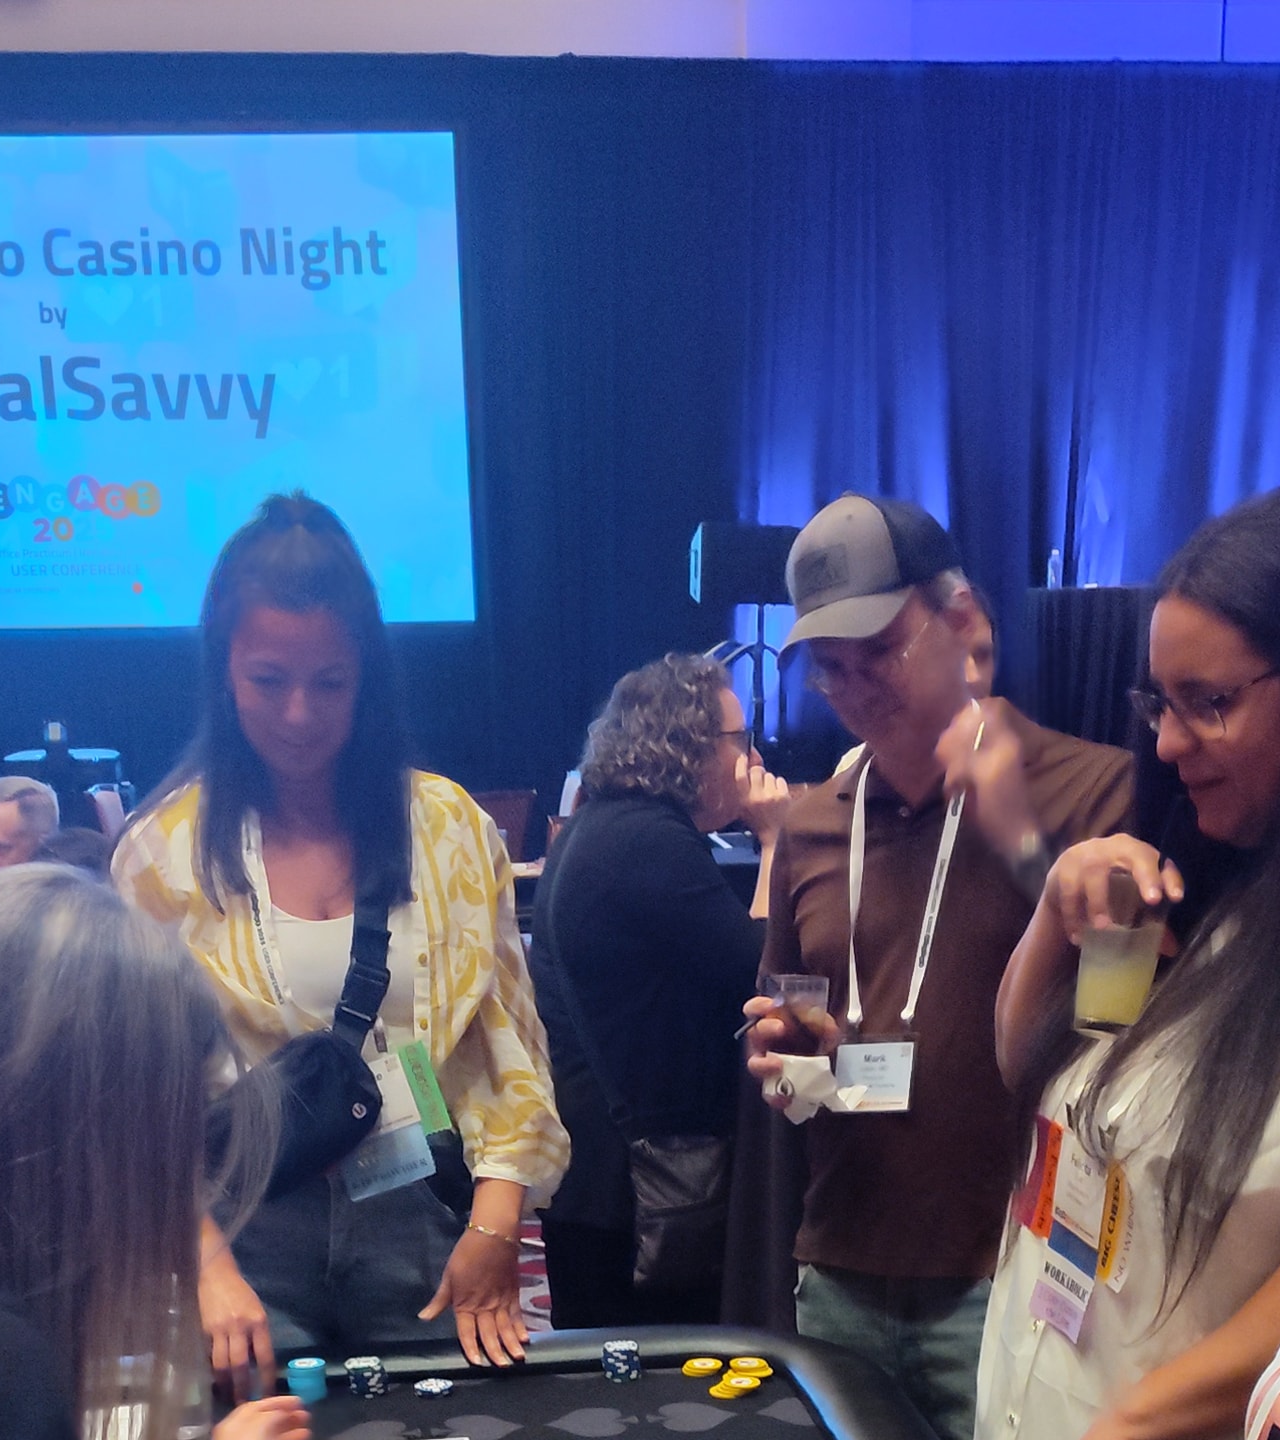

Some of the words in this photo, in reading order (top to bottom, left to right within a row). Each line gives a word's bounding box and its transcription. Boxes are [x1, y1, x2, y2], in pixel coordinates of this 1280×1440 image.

[41, 227, 222, 278] Casino
[240, 226, 388, 291] Night
[38, 301, 68, 330] by
[11, 564, 48, 577] USER
